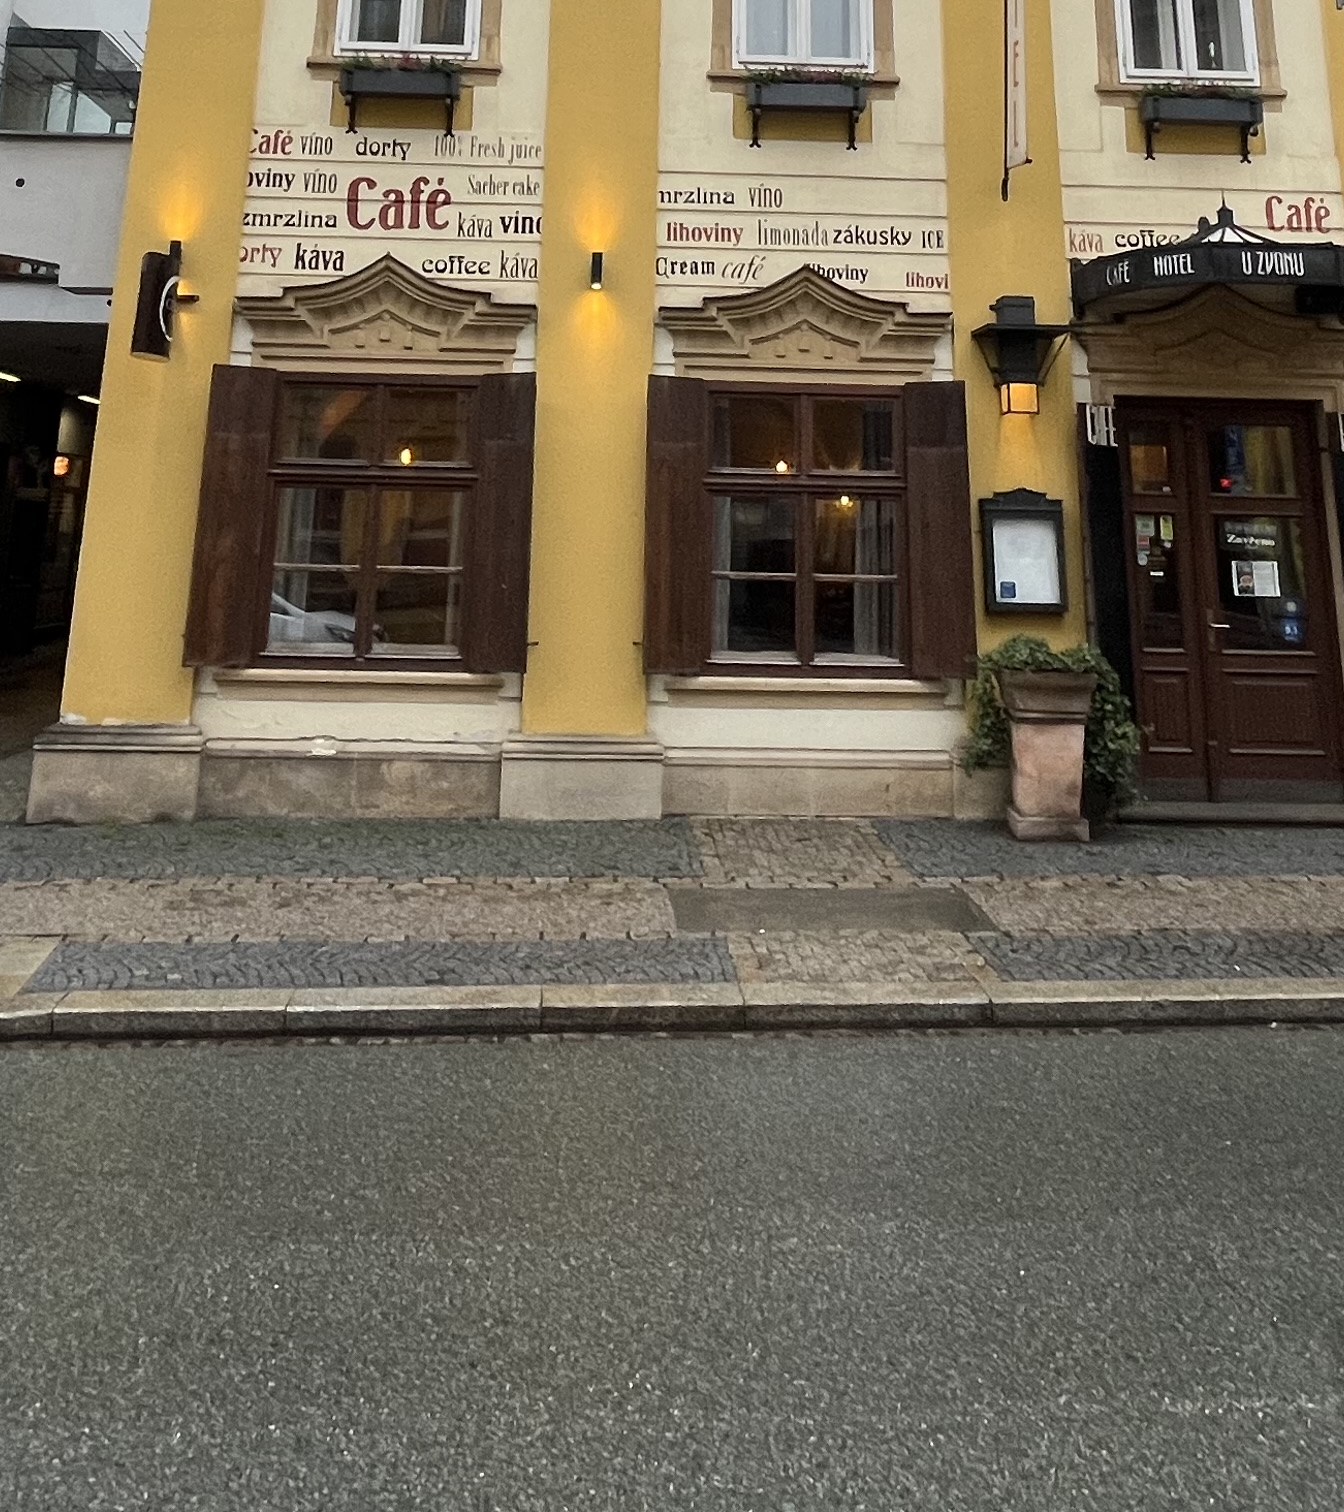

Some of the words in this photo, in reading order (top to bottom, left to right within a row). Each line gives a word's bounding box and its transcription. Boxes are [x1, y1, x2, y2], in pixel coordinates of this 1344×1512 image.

[300, 132, 333, 156] víno
[356, 137, 412, 160] dorty
[470, 135, 506, 159] Fresh
[508, 136, 542, 165] juice
[303, 168, 338, 194] víno
[467, 173, 510, 196] Sacher
[512, 174, 541, 196] cake
[346, 176, 452, 231] Café
[748, 183, 783, 208] víno
[242, 209, 337, 228] zmrzlina
[457, 211, 493, 238] káva
[1265, 195, 1332, 234] Café
[666, 221, 744, 247] lihoviny
[757, 219, 829, 247] limonada
[832, 224, 913, 248] zákusky
[921, 230, 945, 249] ICE
[1068, 227, 1104, 253] káva
[1115, 230, 1181, 248] coffee
[294, 242, 346, 271] káva
[421, 255, 491, 275] coffee
[499, 249, 539, 279] káva
[721, 254, 767, 285] café
[1153, 253, 1196, 277] HOTEL
[1241, 250, 1253, 276] U
[1256, 250, 1305, 278] ZVONU
[806, 263, 869, 285] hoviny
[905, 271, 949, 289] lihovi
